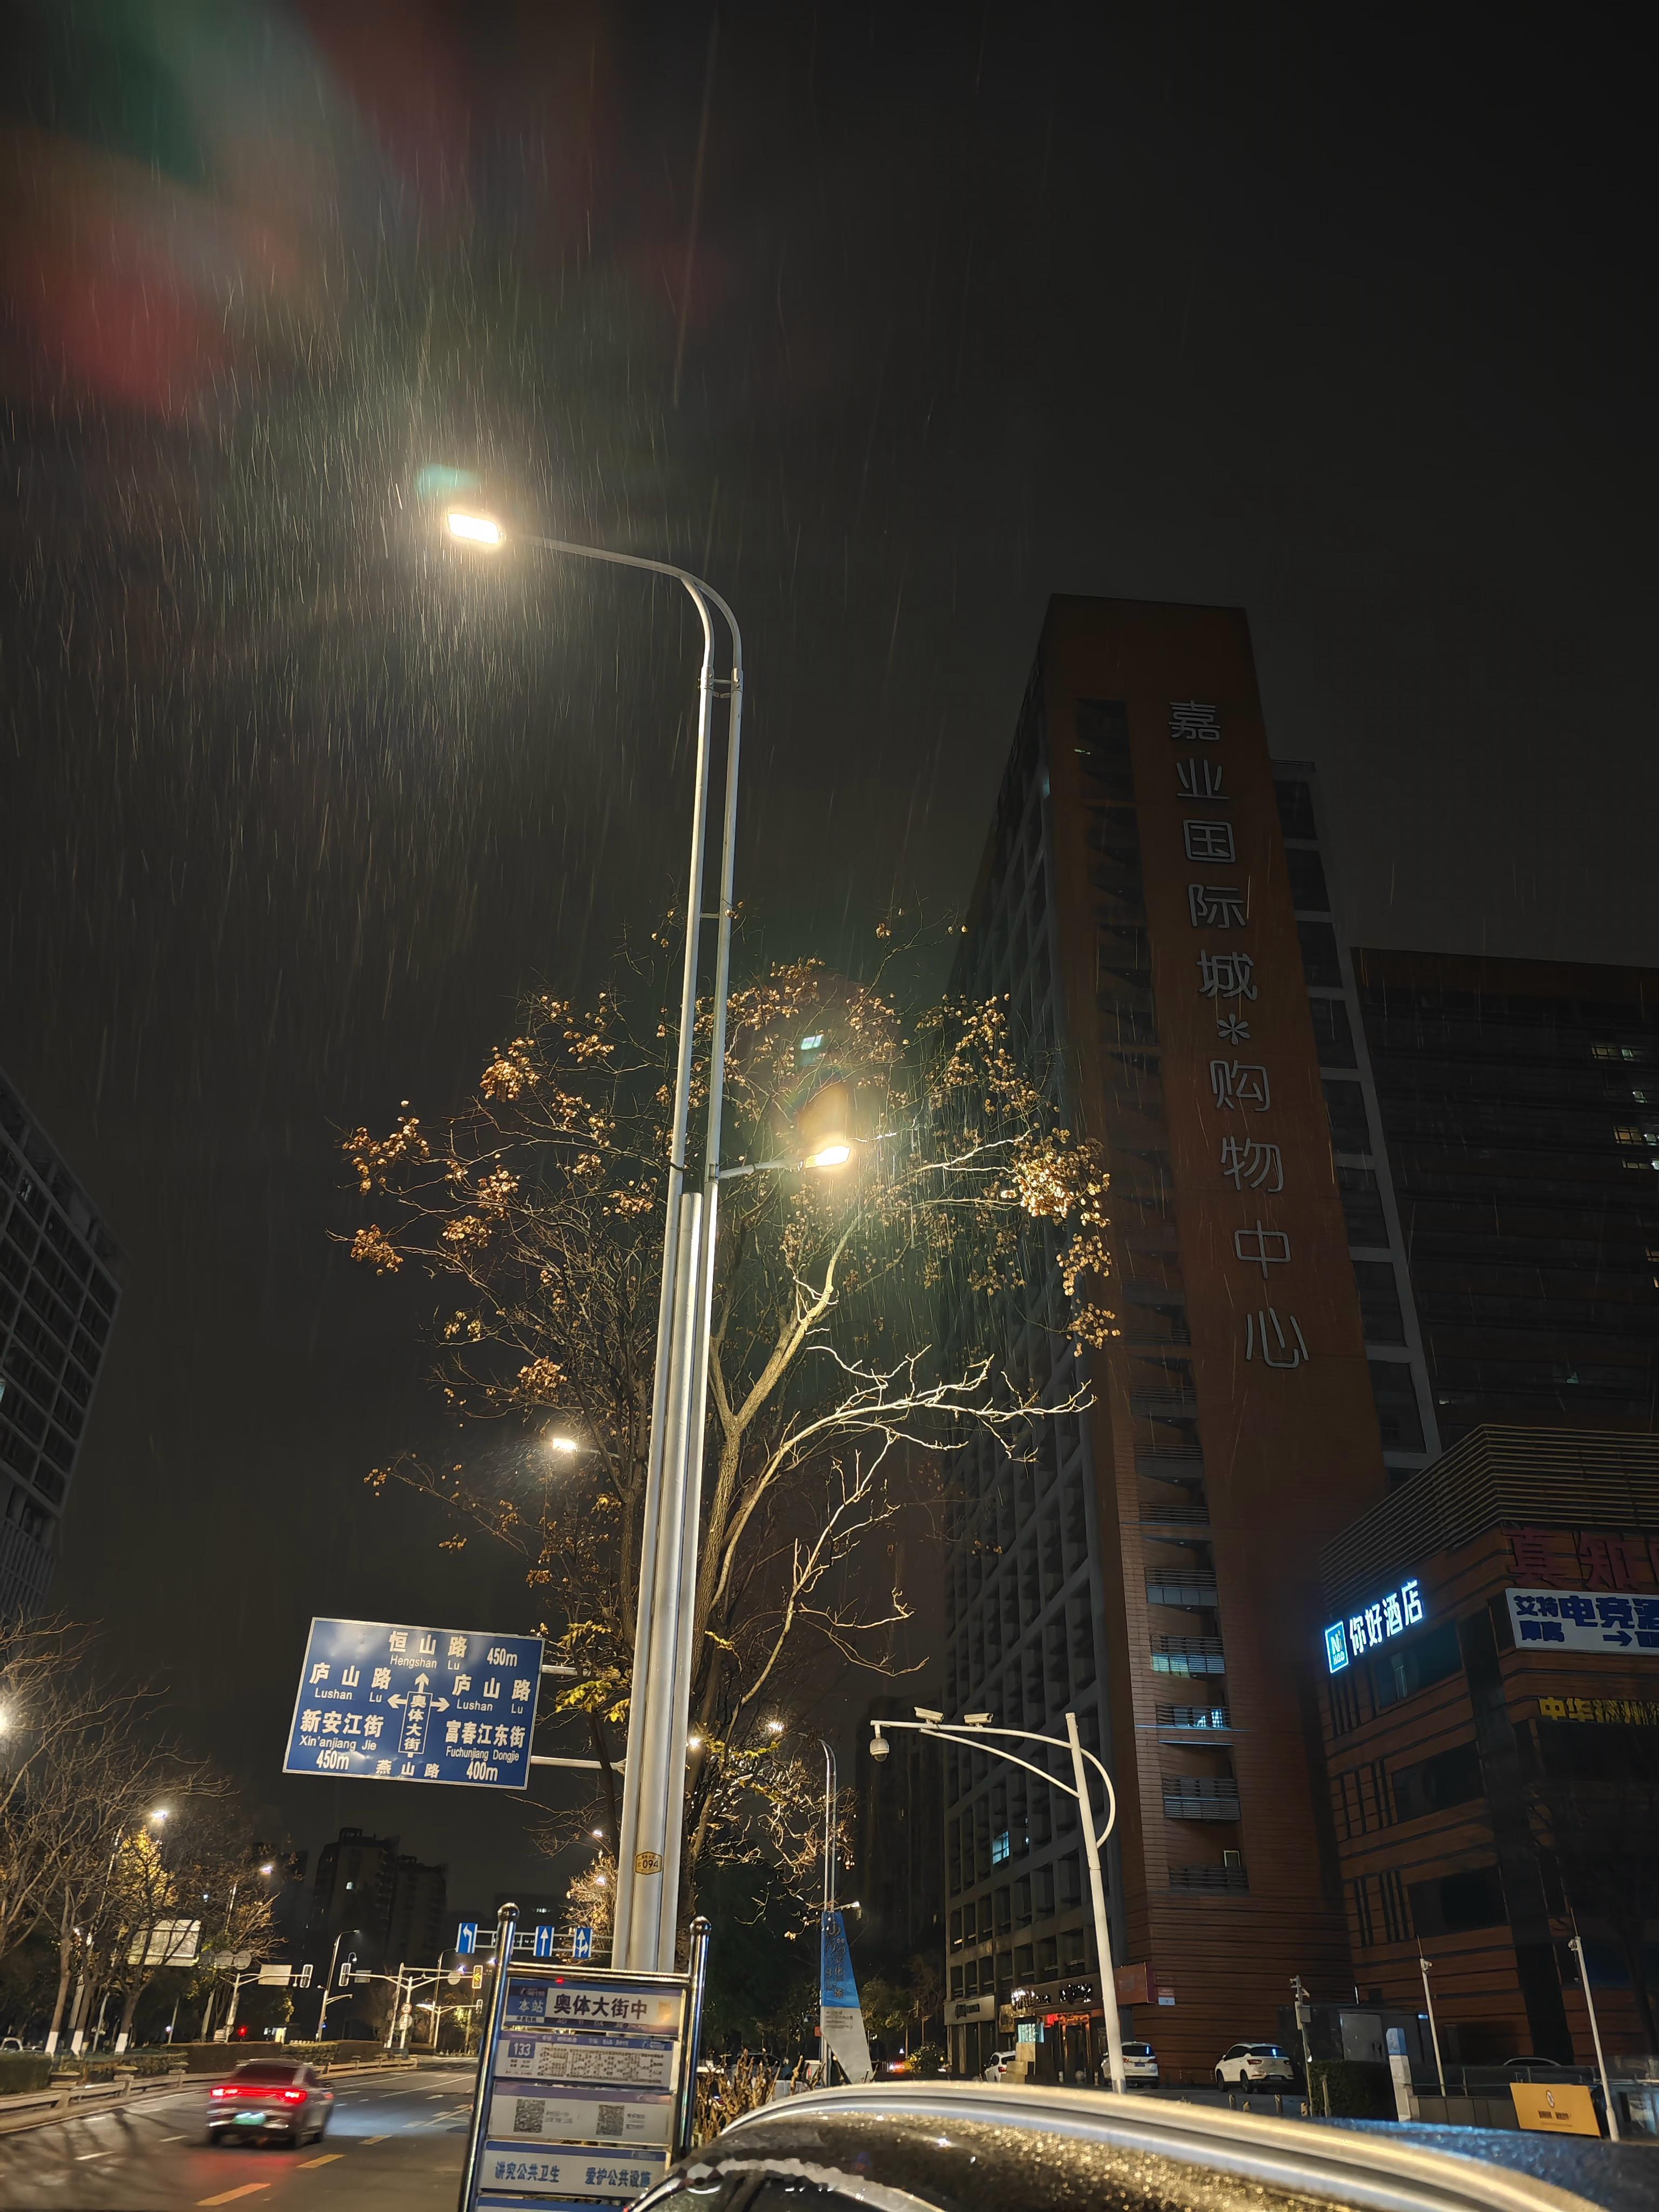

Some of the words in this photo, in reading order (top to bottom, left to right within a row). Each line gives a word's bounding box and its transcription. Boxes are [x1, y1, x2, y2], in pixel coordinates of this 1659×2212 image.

[1350, 1579, 1422, 1656] 你好酒店
[389, 1631, 467, 1658] 恒山路
[390, 1655, 437, 1669] Hengshan
[448, 1660, 460, 1670] Lu
[487, 1648, 517, 1667] 450m
[309, 1662, 392, 1690] 庐山路
[315, 1688, 352, 1701] Lushan
[369, 1692, 382, 1703] Lu
[452, 1674, 531, 1702] 庐山路
[457, 1700, 493, 1712] Lushan
[511, 1704, 523, 1714] Lu
[300, 1709, 384, 1738] 新安江街
[403, 1695, 427, 1752] 奥体大街
[446, 1720, 525, 1749] 富春江东街
[361, 1740, 377, 1751] Jie
[446, 1746, 488, 1761] Fuchunjiang
[493, 1750, 520, 1763] Dongjie
[316, 1751, 349, 1771] 450m
[376, 1759, 440, 1778] 燕山路
[466, 1761, 498, 1782] 400m
[518, 1999, 544, 2013] 本站
[554, 1994, 648, 2020] 奥体大街中
[514, 2042, 531, 2056] 133
